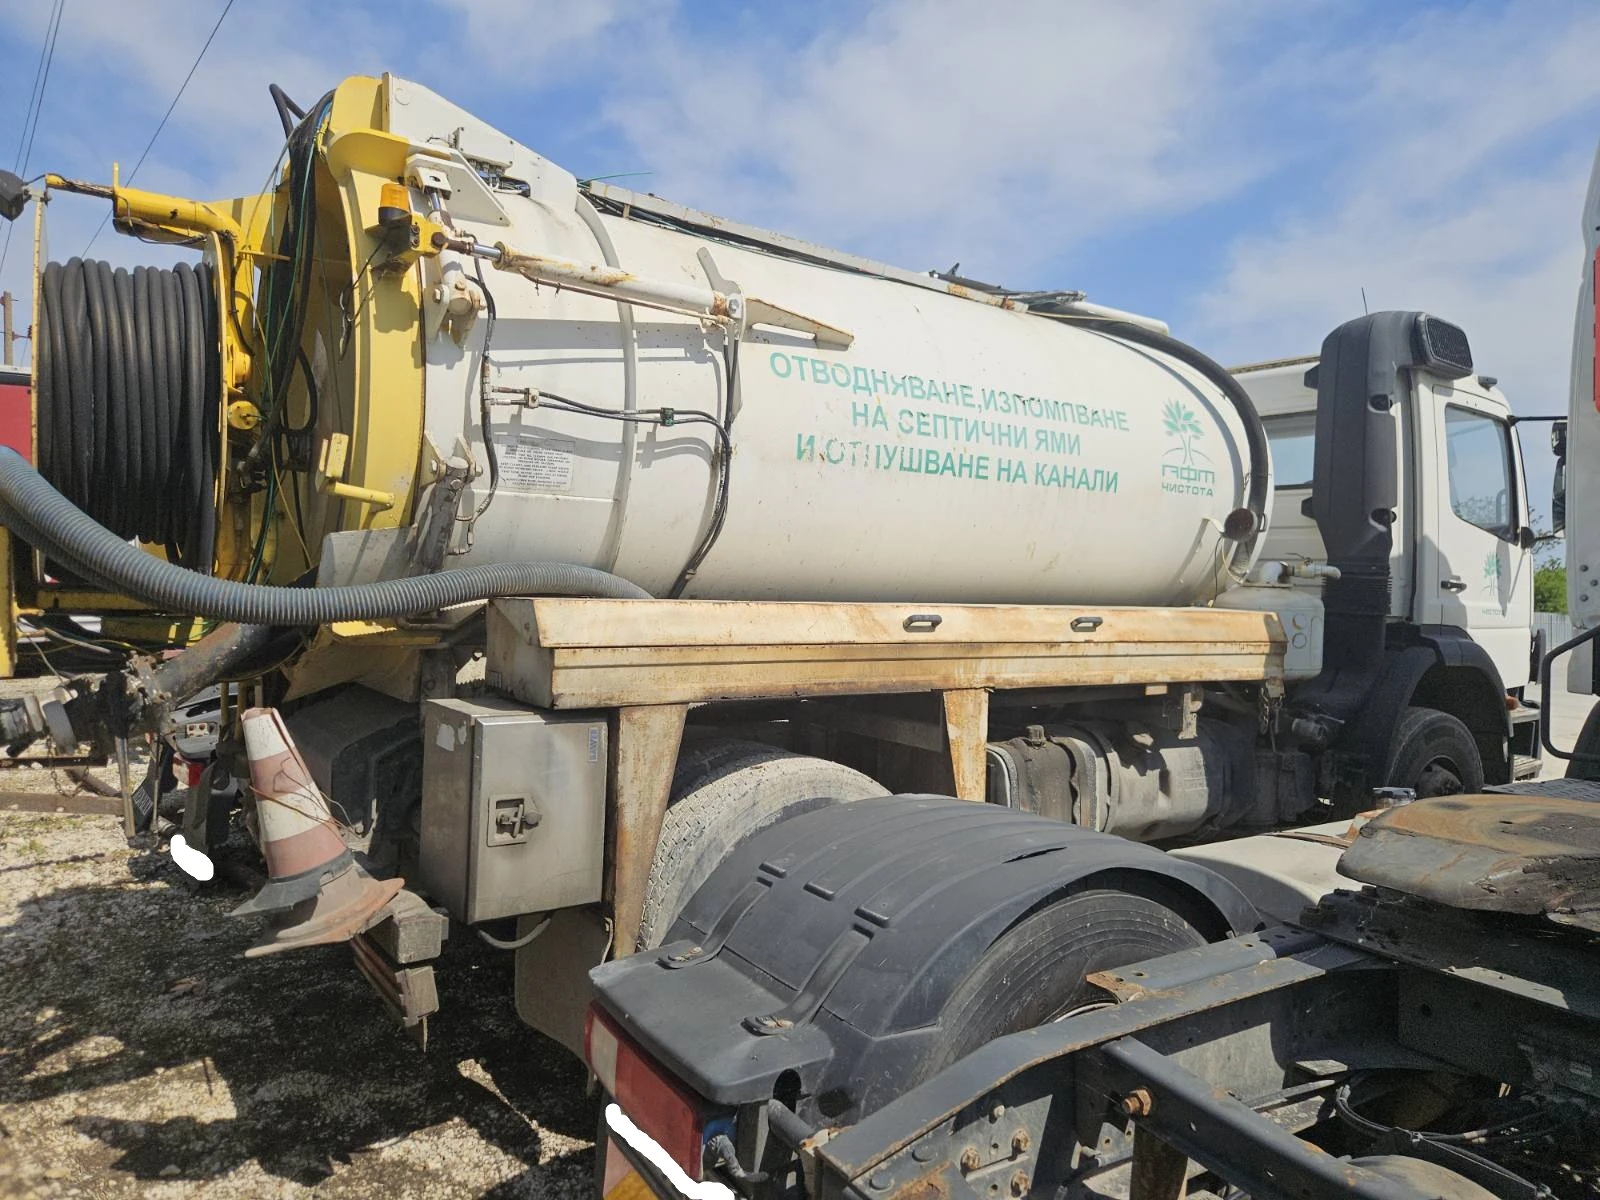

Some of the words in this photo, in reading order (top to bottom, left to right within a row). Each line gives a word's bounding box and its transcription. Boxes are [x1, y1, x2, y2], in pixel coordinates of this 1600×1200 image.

[852, 402, 889, 431] НА
[897, 408, 1028, 449] СЕПТИЧНИ
[1034, 428, 1081, 457] ЯМИ
[796, 433, 815, 461] И
[997, 457, 1028, 485] НА
[1034, 461, 1119, 494] КАНАЛИ
[1161, 482, 1214, 498] ЧИСТОТА
